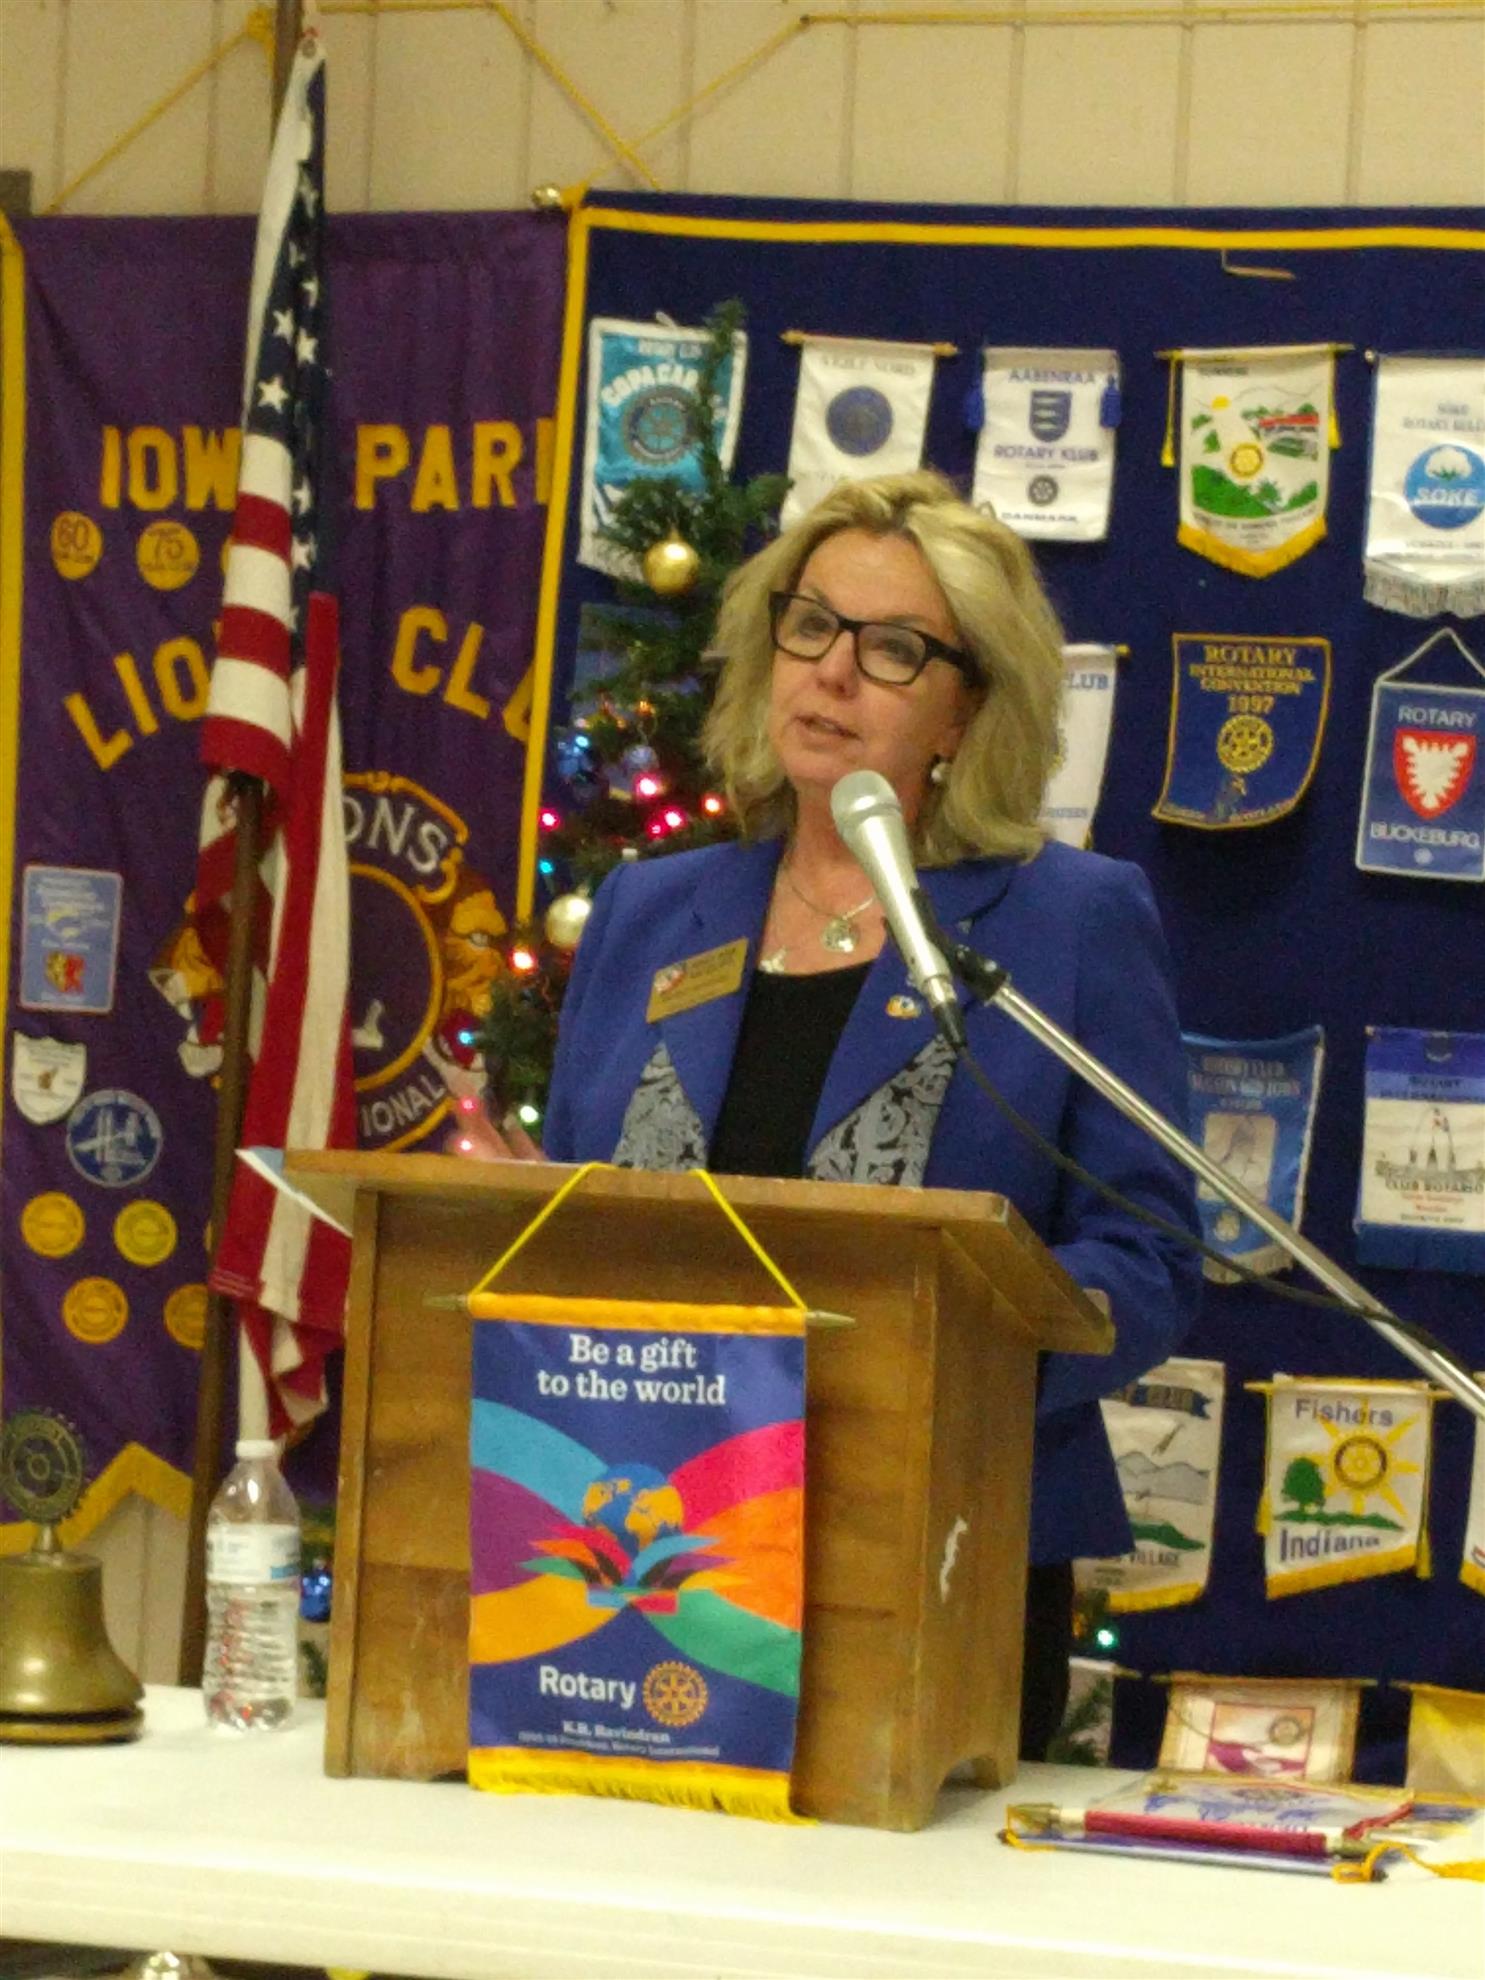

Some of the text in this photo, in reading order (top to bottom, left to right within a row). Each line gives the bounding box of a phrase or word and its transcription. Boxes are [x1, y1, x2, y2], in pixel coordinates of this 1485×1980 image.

[101, 424, 240, 511] IOW
[1204, 644, 1297, 666] ROTARY
[1398, 705, 1477, 728] ROTARY
[569, 1334, 697, 1373] Be a gift
[537, 1369, 726, 1406] to the world
[1295, 1398, 1394, 1427] Fishers
[1279, 1528, 1382, 1563] Indiana
[539, 1665, 636, 1711] Rotary
